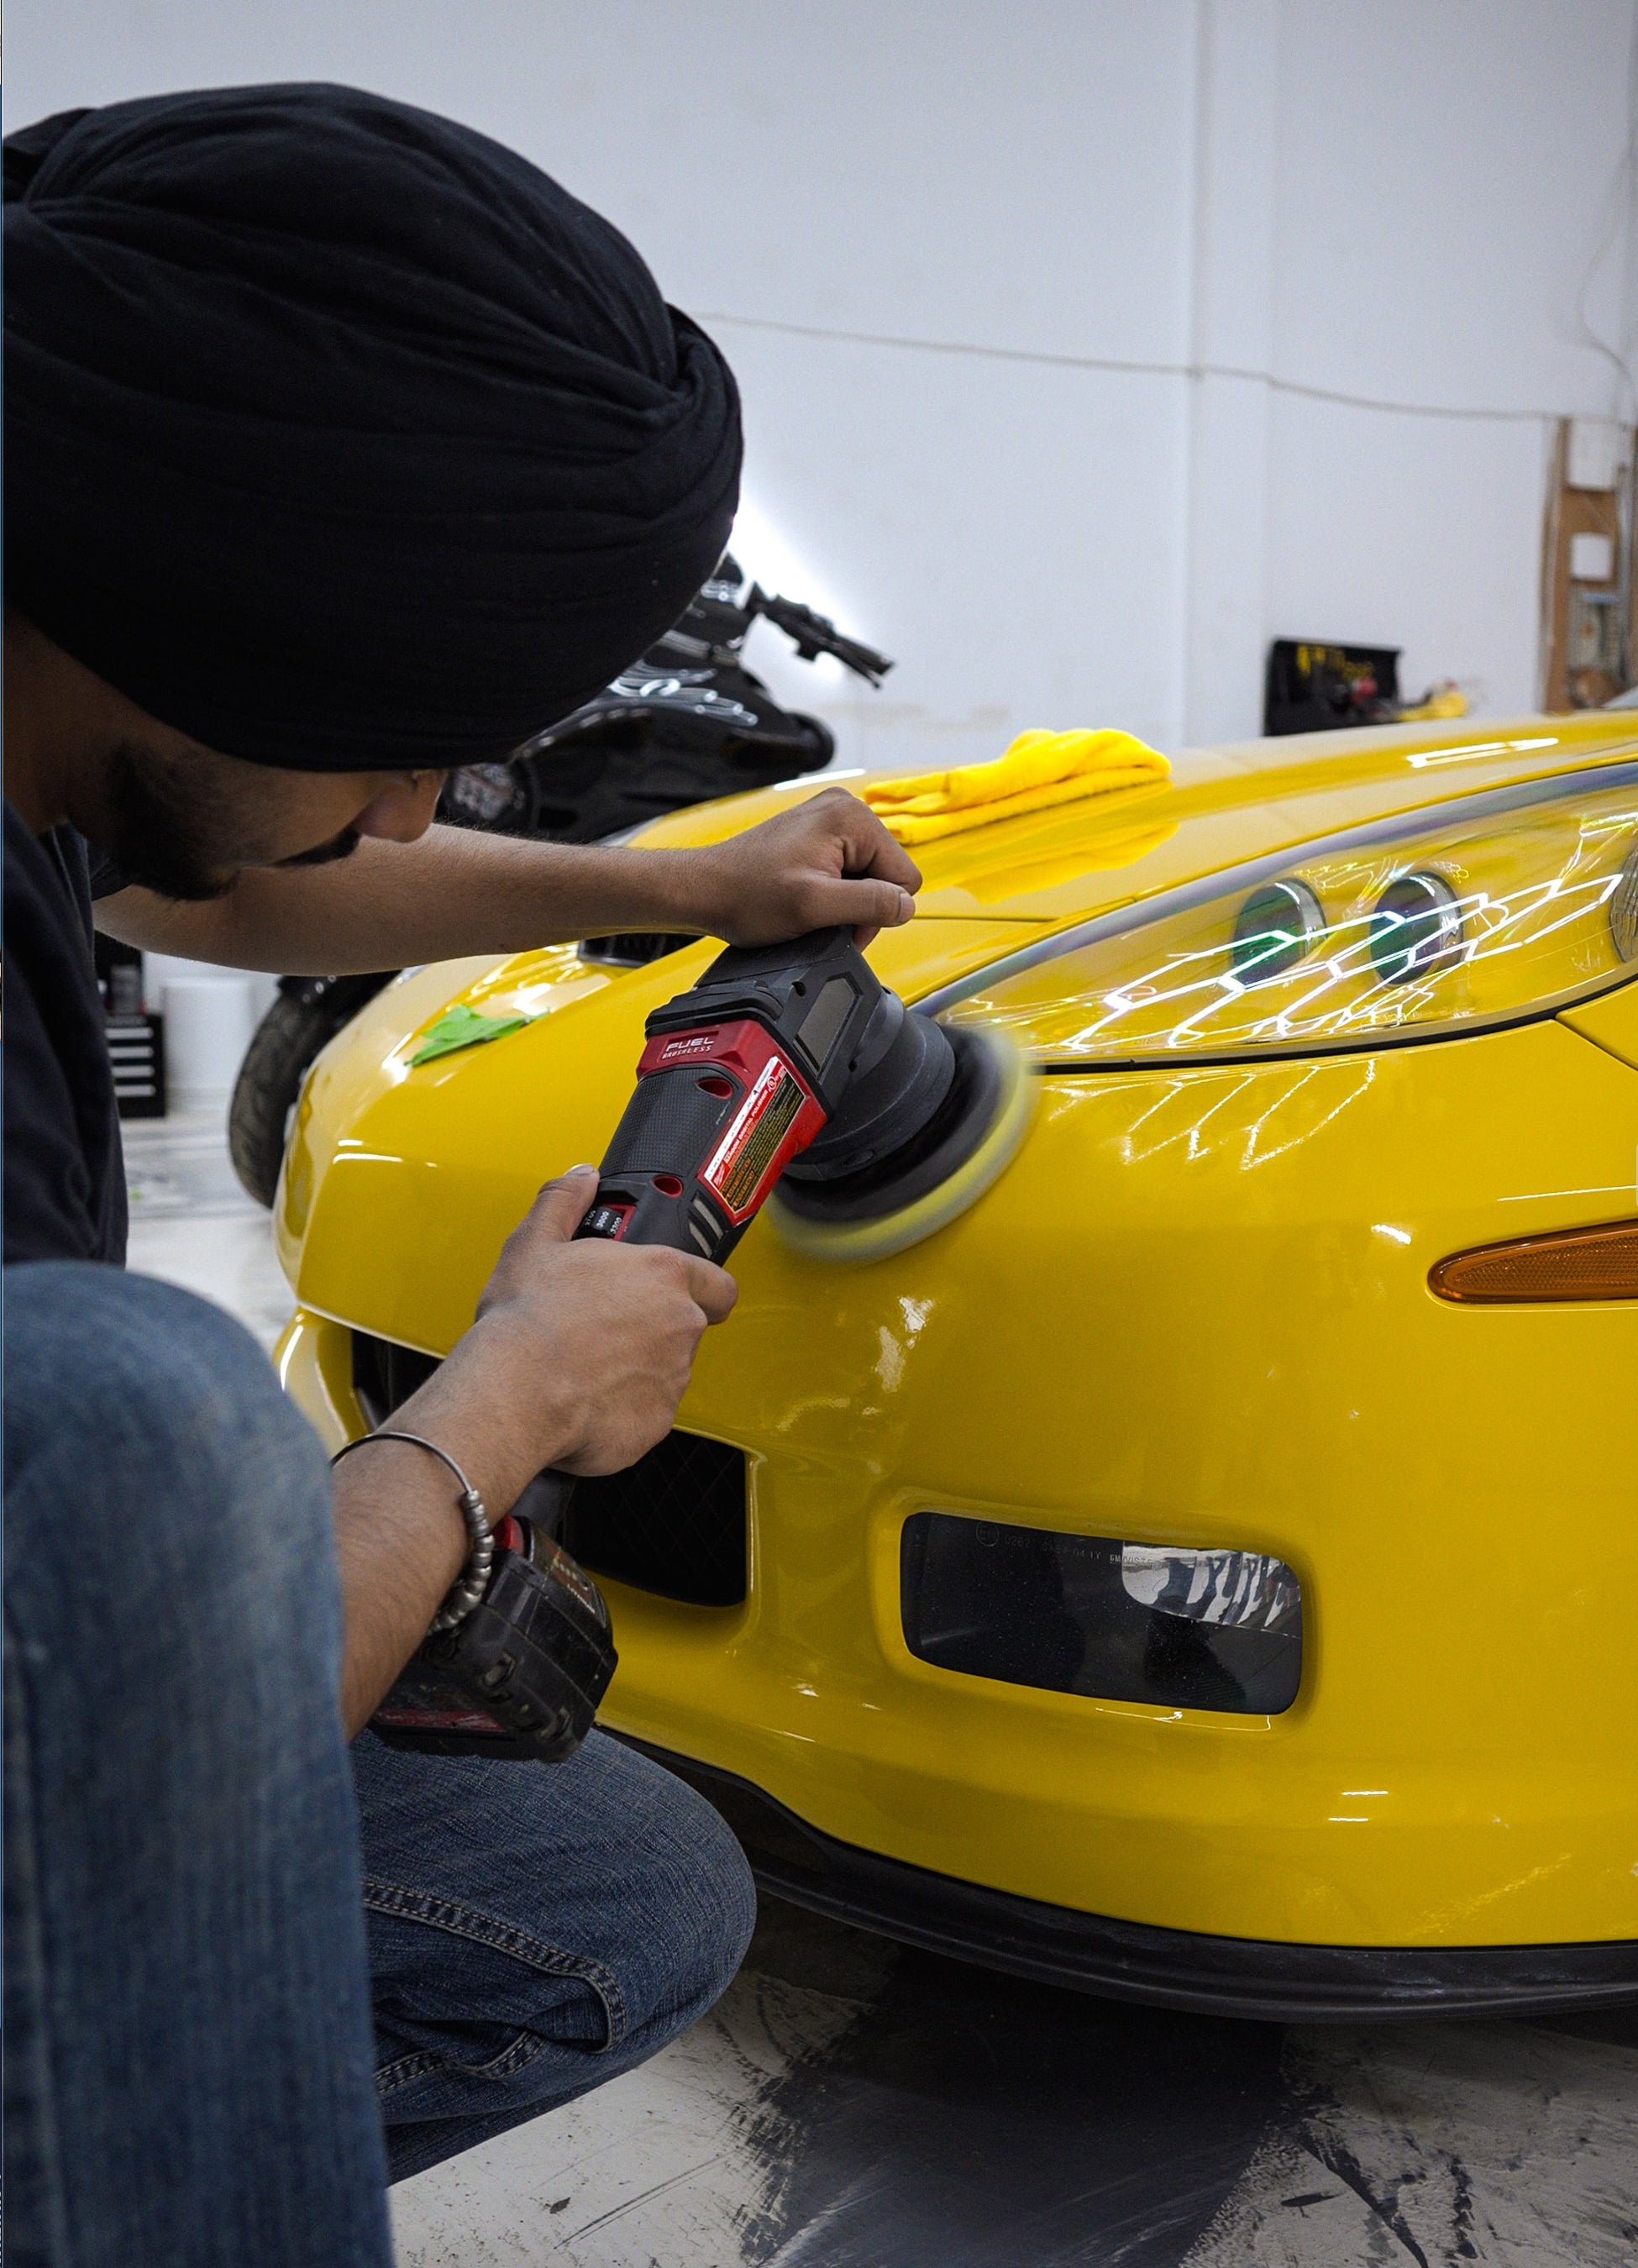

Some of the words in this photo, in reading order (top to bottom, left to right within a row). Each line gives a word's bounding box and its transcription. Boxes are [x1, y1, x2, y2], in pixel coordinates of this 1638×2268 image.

[666, 1037, 714, 1052] FUEL
[662, 1046, 711, 1059] BRUSHLESS
[752, 1089, 769, 1117] POLISHER
[596, 1211, 609, 1227] 3000
